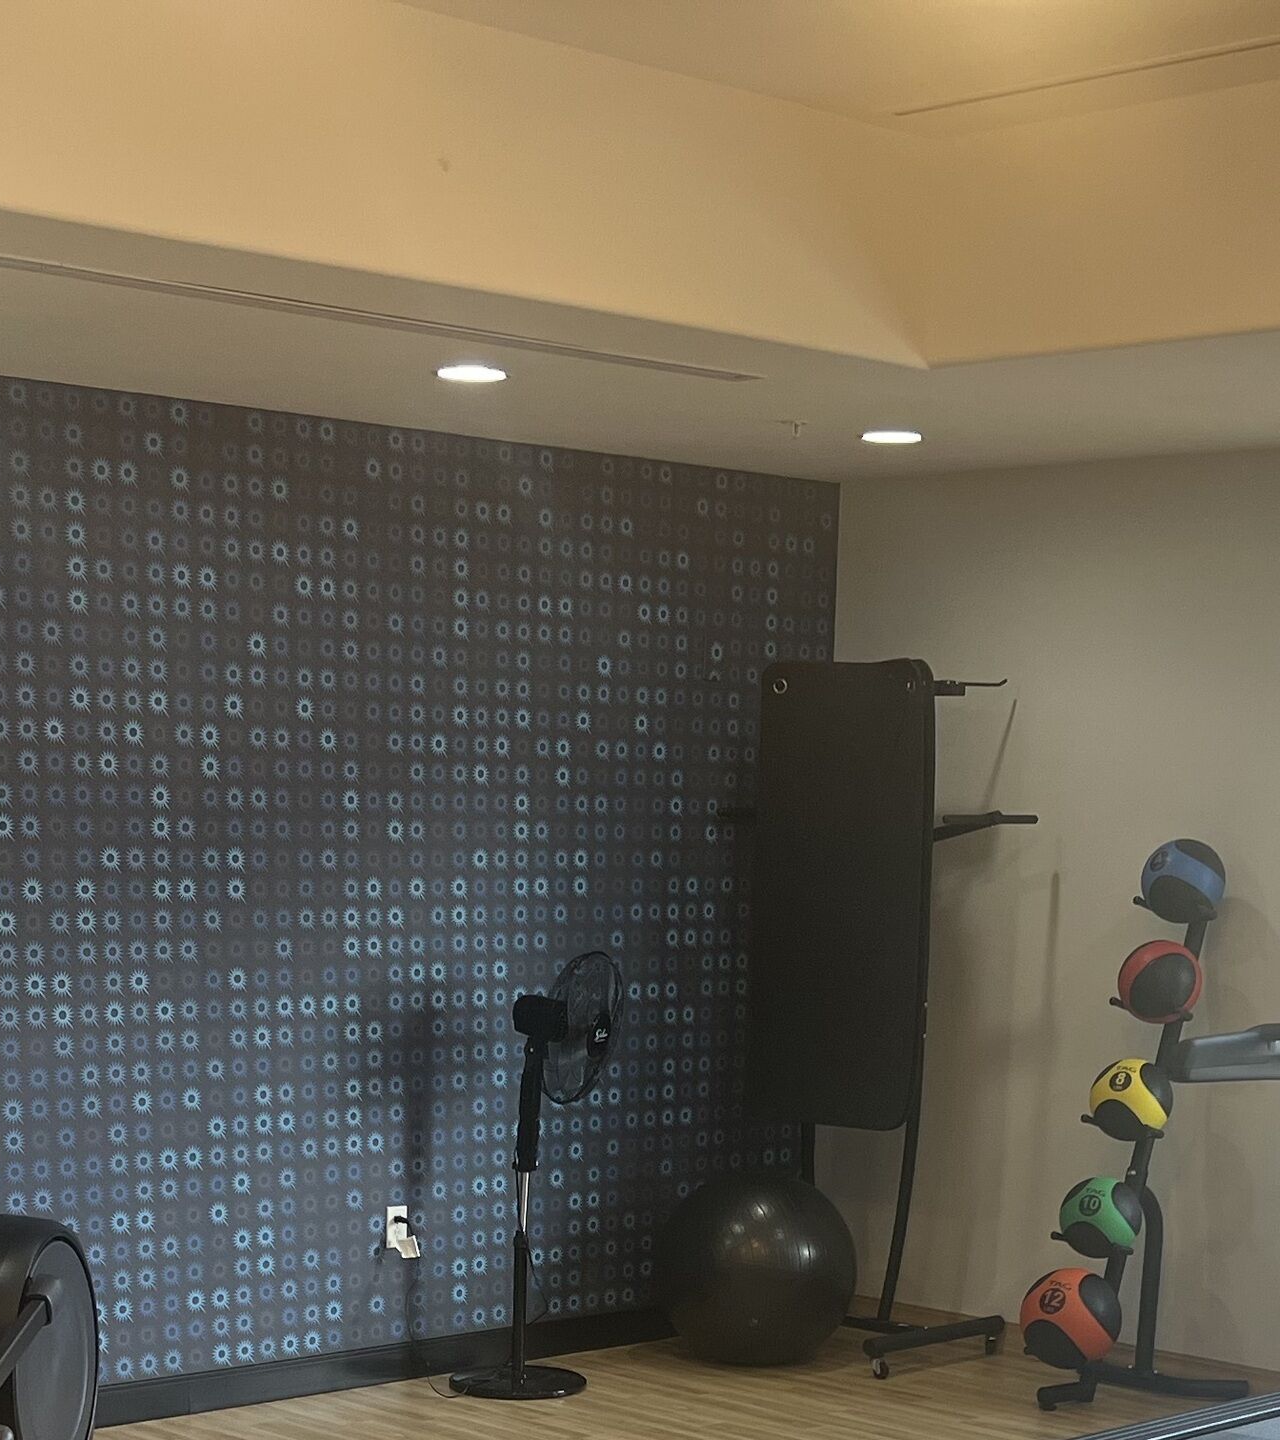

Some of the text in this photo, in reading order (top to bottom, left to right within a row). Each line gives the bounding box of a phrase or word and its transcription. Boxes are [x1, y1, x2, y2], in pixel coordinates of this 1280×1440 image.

[1116, 1072, 1126, 1085] 8
[1083, 1196, 1099, 1210] 10
[1044, 1290, 1063, 1307] 12
